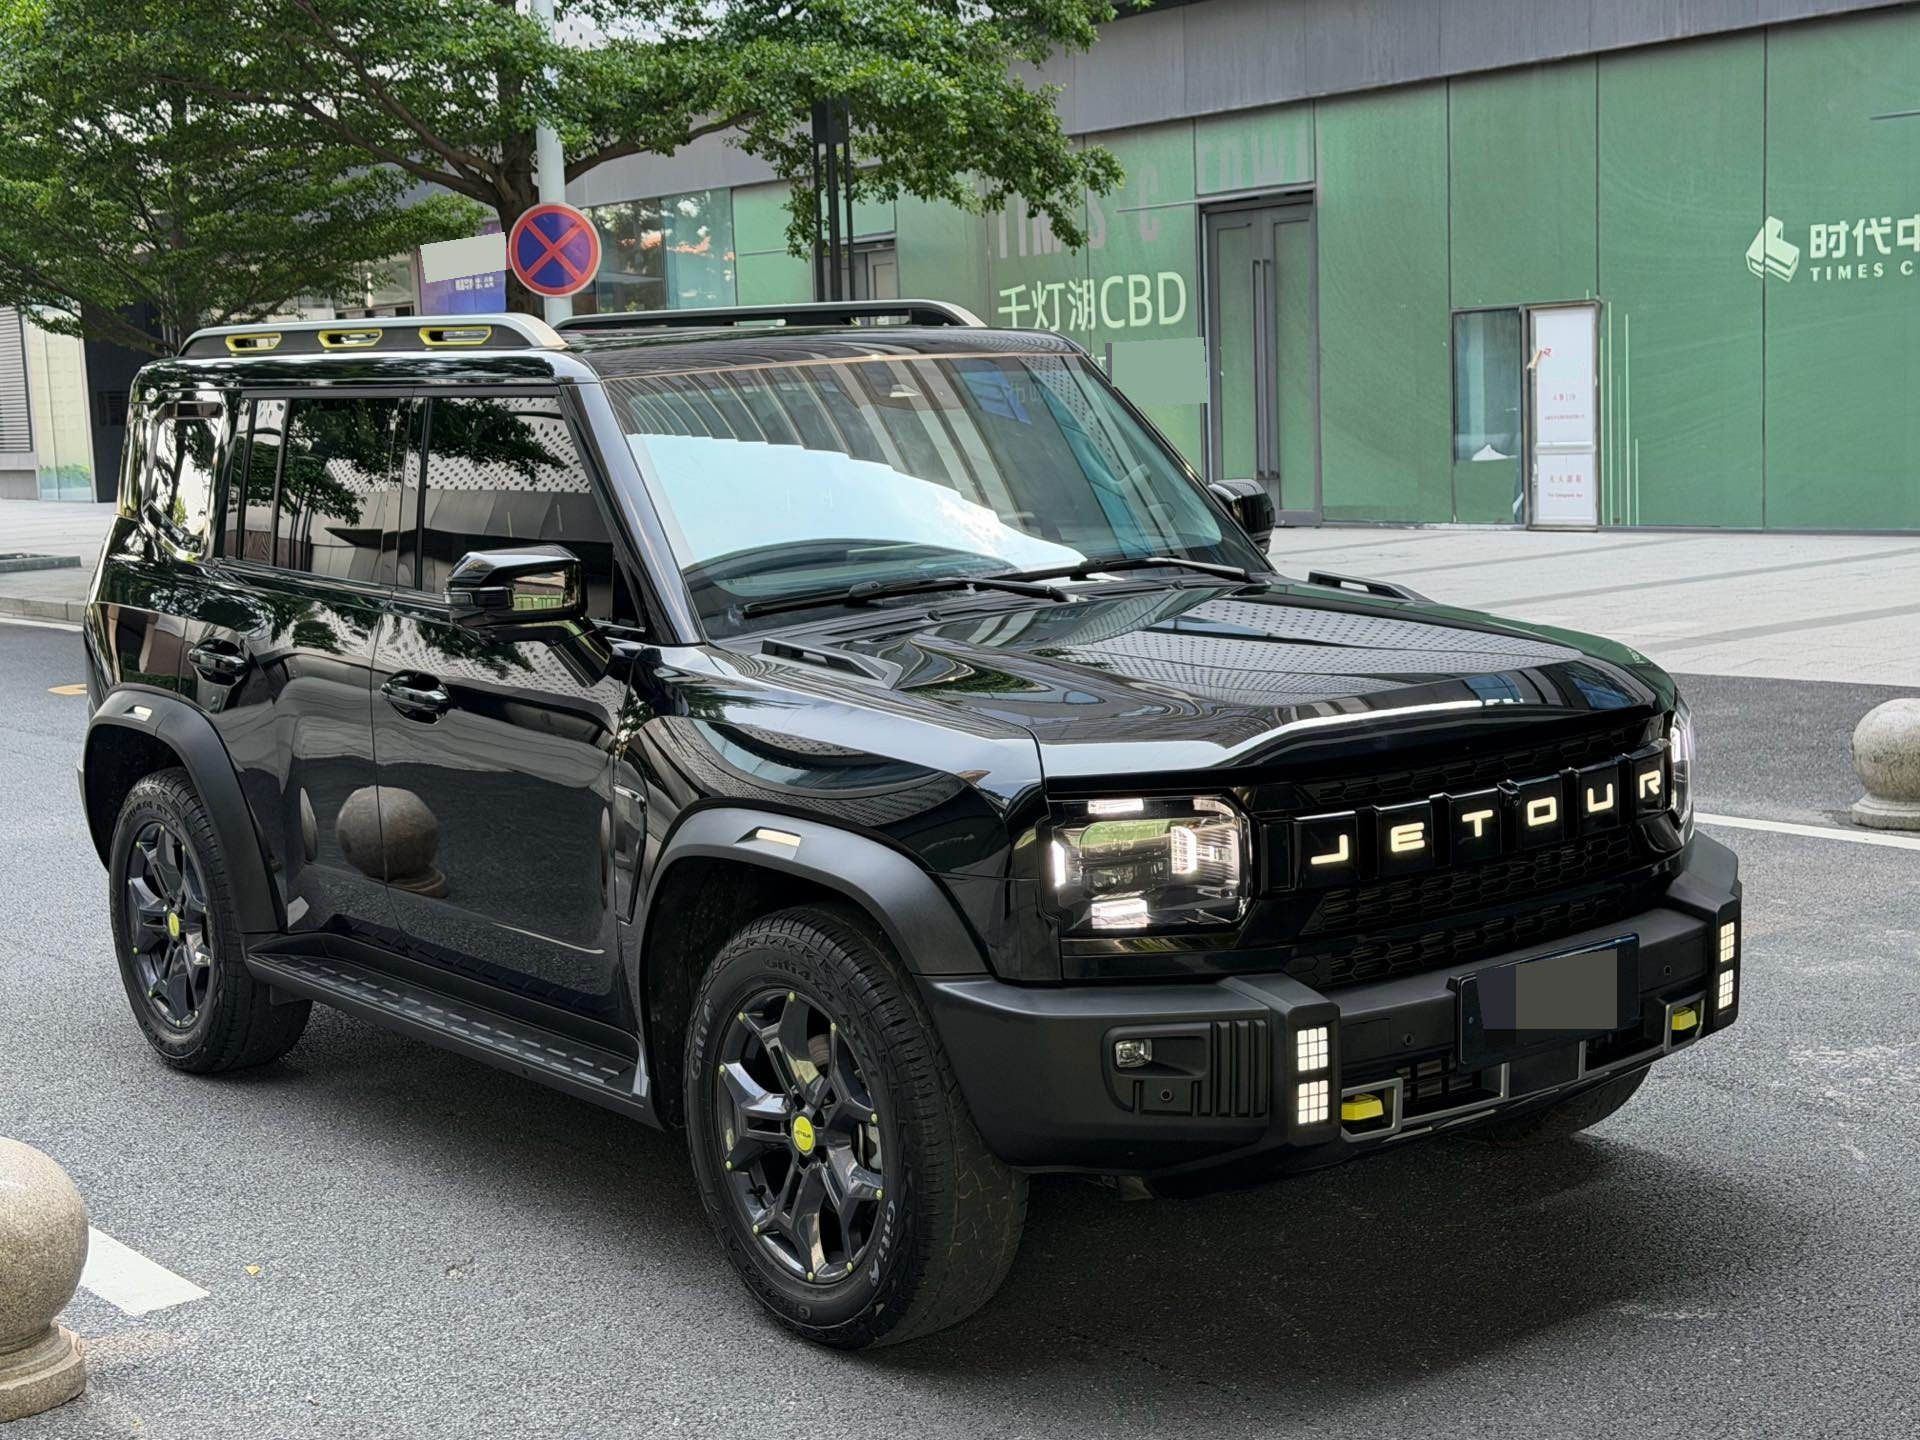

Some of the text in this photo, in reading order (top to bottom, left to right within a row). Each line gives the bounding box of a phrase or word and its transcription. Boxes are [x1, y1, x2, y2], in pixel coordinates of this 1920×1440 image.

[1810, 214, 1920, 259] 时代中
[1810, 262, 1885, 282] TIMES
[998, 272, 1187, 333] 千灯湖CBD
[1310, 769, 1662, 865] JETOUR
